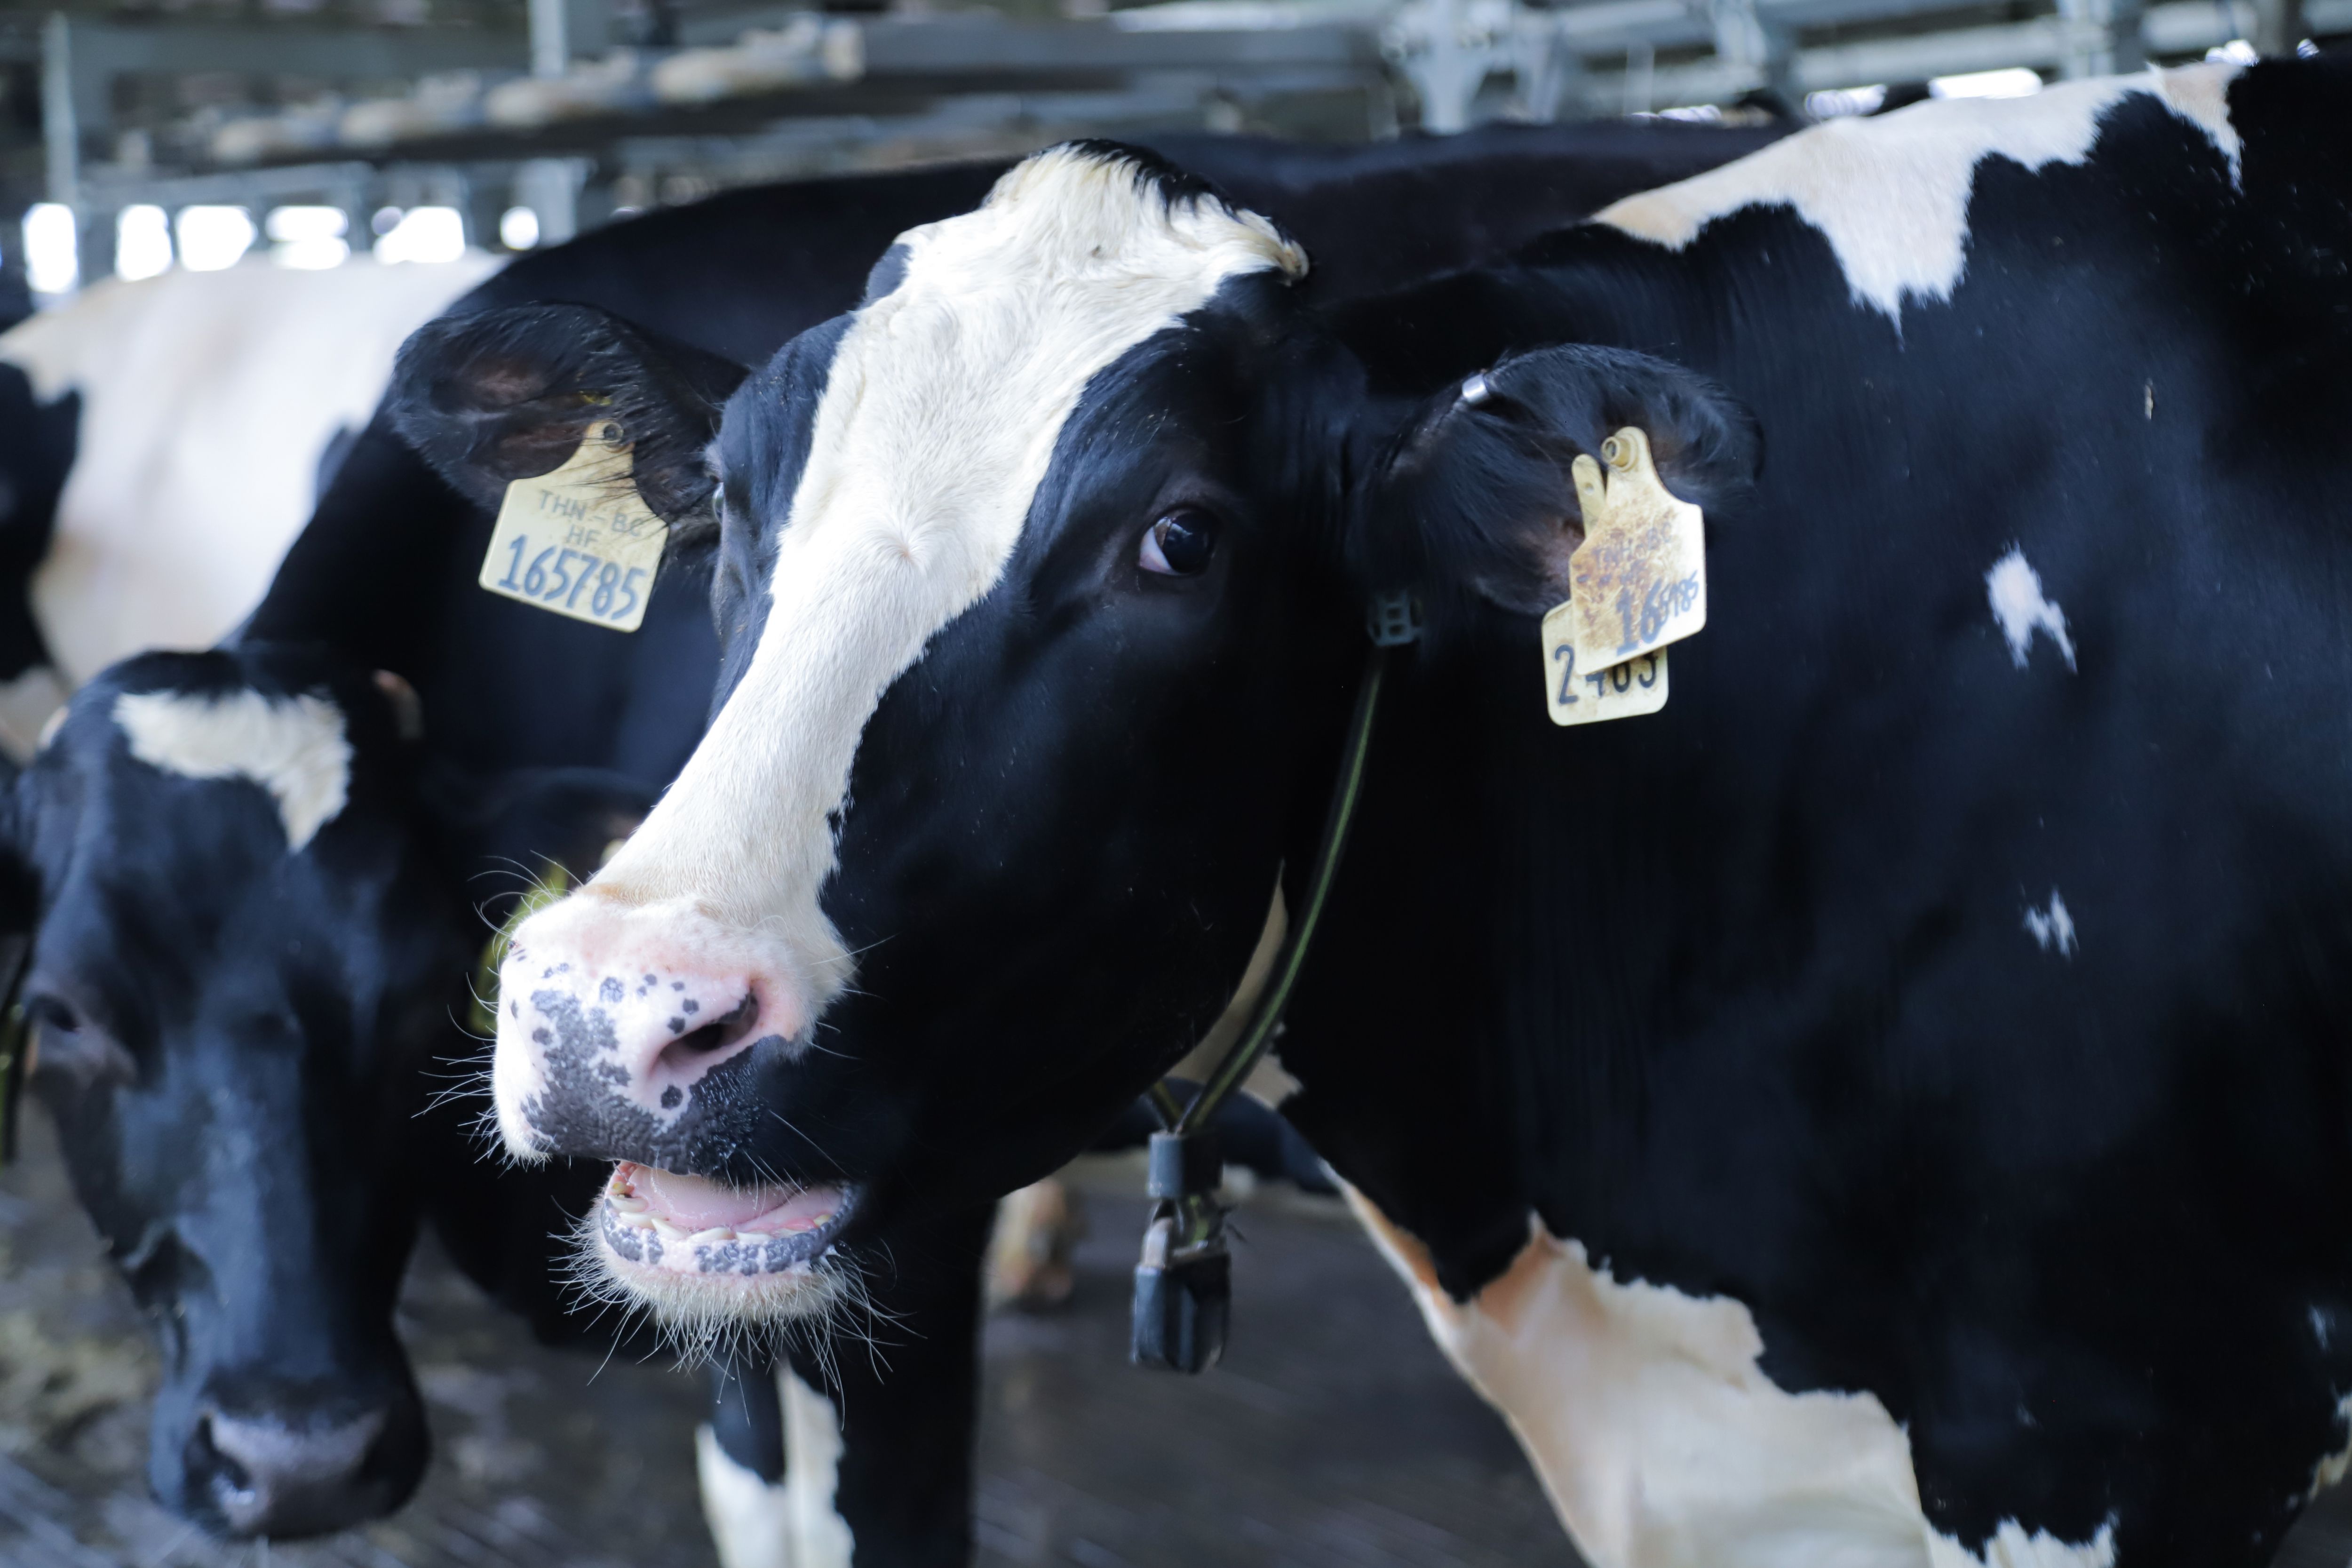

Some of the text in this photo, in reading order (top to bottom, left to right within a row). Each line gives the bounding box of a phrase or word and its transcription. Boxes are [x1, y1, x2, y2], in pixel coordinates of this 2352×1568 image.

[497, 533, 647, 621] 165785
[566, 524, 600, 547] HF
[1616, 569, 1699, 656] 165785
